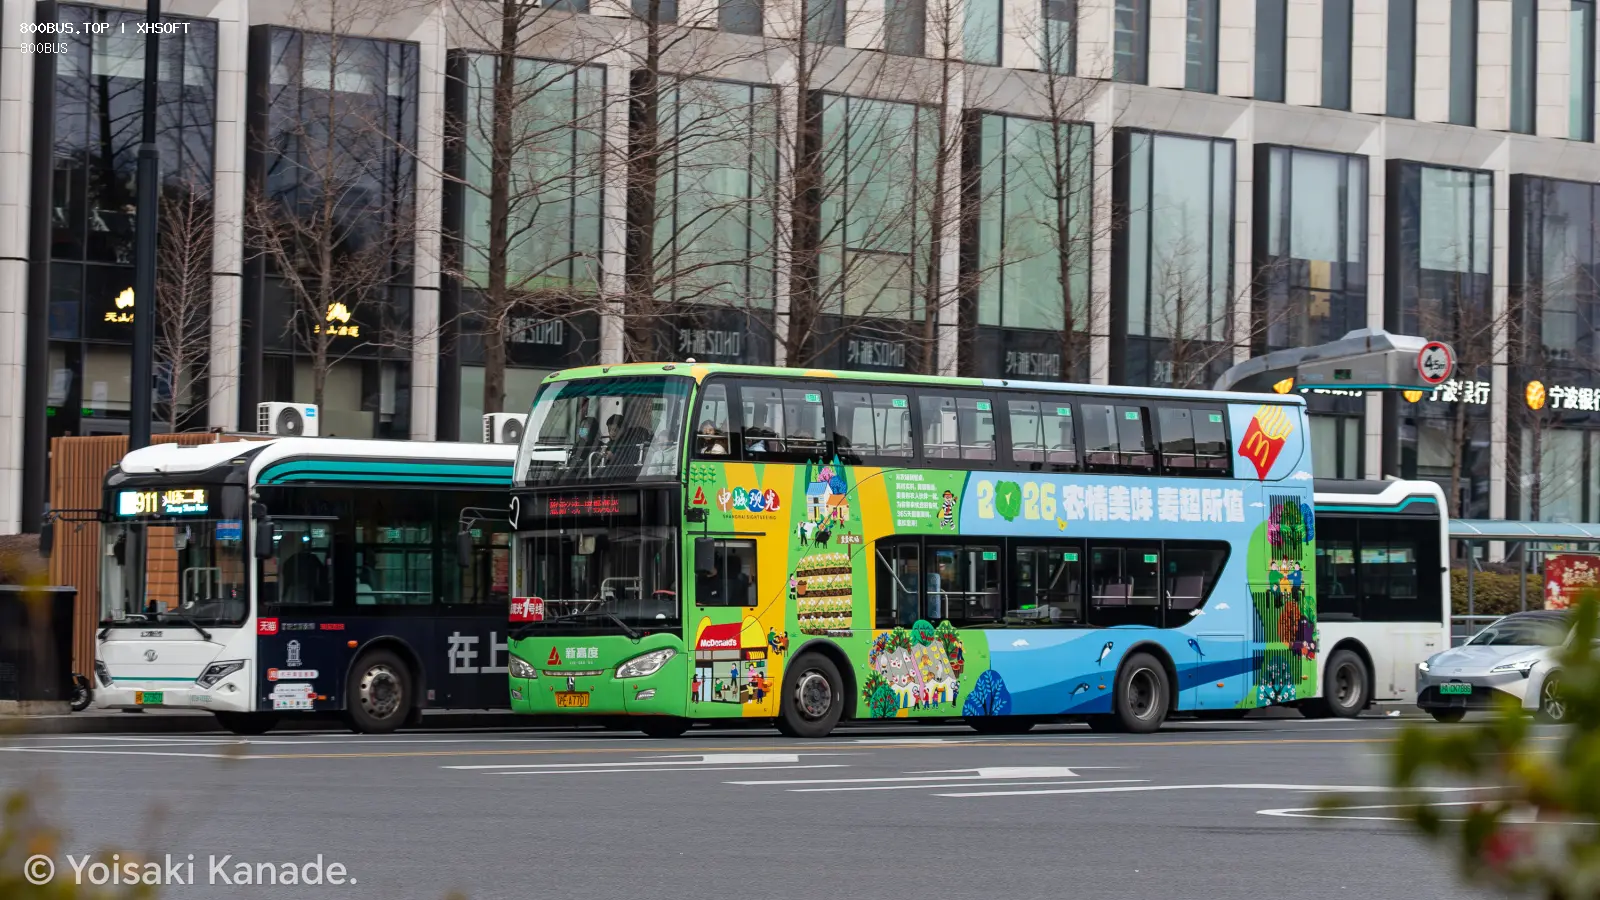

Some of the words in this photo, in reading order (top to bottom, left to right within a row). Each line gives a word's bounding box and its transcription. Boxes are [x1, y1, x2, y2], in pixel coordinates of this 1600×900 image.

[136, 491, 158, 513] 911
[565, 646, 599, 659] 新高度
